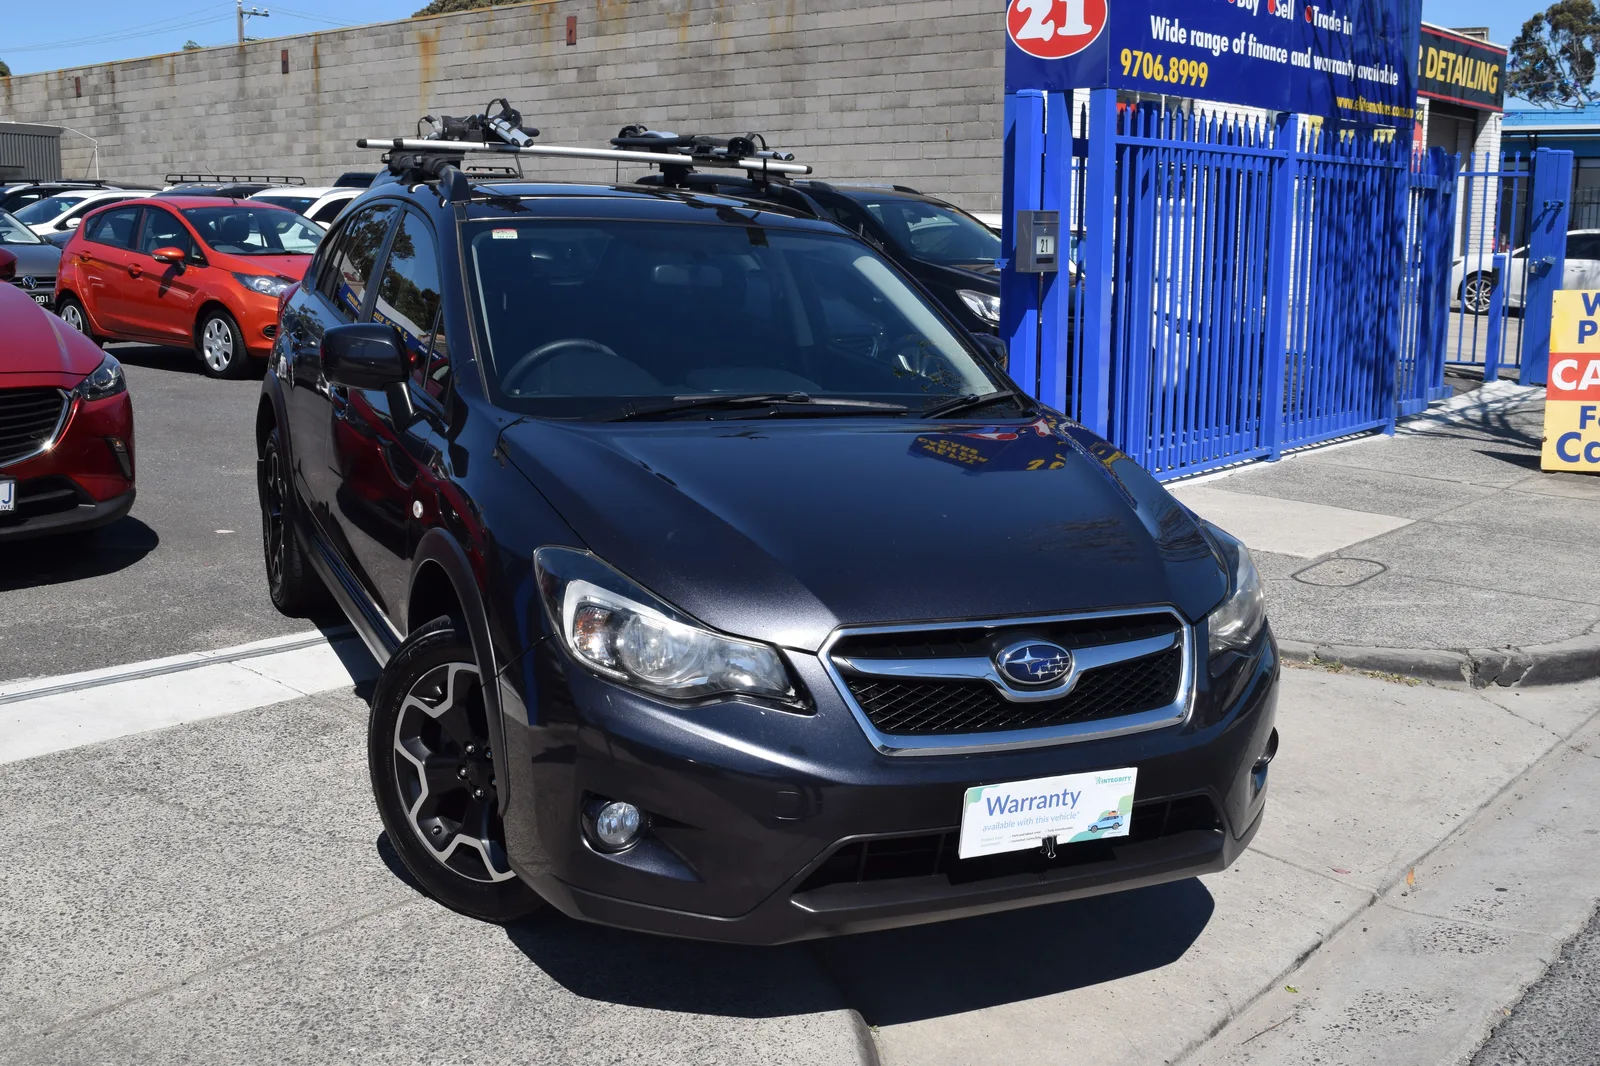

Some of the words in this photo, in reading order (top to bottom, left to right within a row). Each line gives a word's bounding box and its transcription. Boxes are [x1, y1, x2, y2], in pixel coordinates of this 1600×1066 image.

[1015, 0, 1093, 41] 21
[1312, 5, 1341, 32] Trade
[1343, 15, 1353, 35] in
[1120, 48, 1208, 88] 9706.8999
[1150, 15, 1187, 44] Wide
[1190, 30, 1229, 57] range
[1232, 32, 1246, 55] of
[1248, 33, 1288, 63] finance
[1291, 47, 1312, 68] and
[1313, 55, 1356, 82] warranty
[1357, 62, 1399, 86] available
[1425, 46, 1499, 94] DETAILING
[1040, 238, 1049, 253] 21
[986, 788, 1082, 817] Warranty
[981, 820, 1016, 832] available
[1016, 817, 1034, 827] with
[1035, 814, 1050, 824] this
